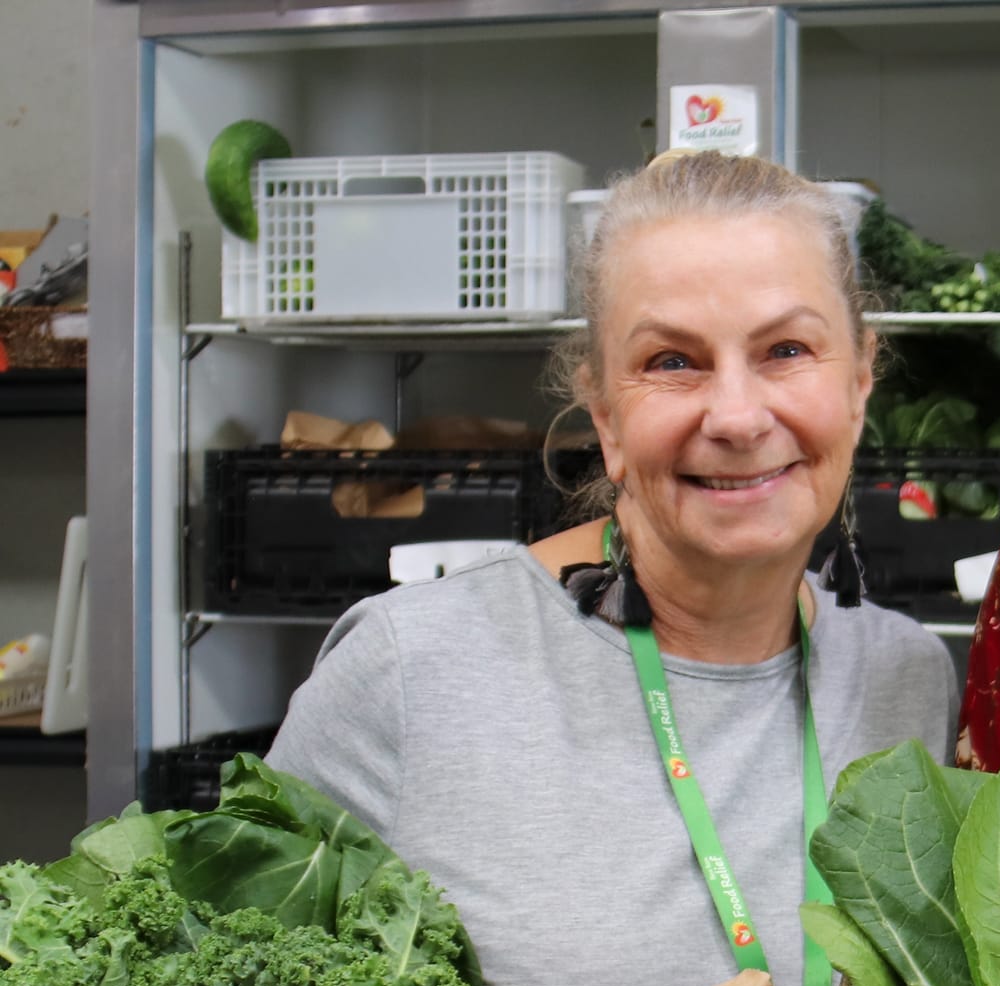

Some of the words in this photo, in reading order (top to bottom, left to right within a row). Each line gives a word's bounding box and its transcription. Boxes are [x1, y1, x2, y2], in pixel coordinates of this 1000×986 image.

[653, 689, 675, 727] Relief
[669, 726, 683, 755] Food
[711, 854, 734, 891] Relief
[723, 885, 745, 918] Food
